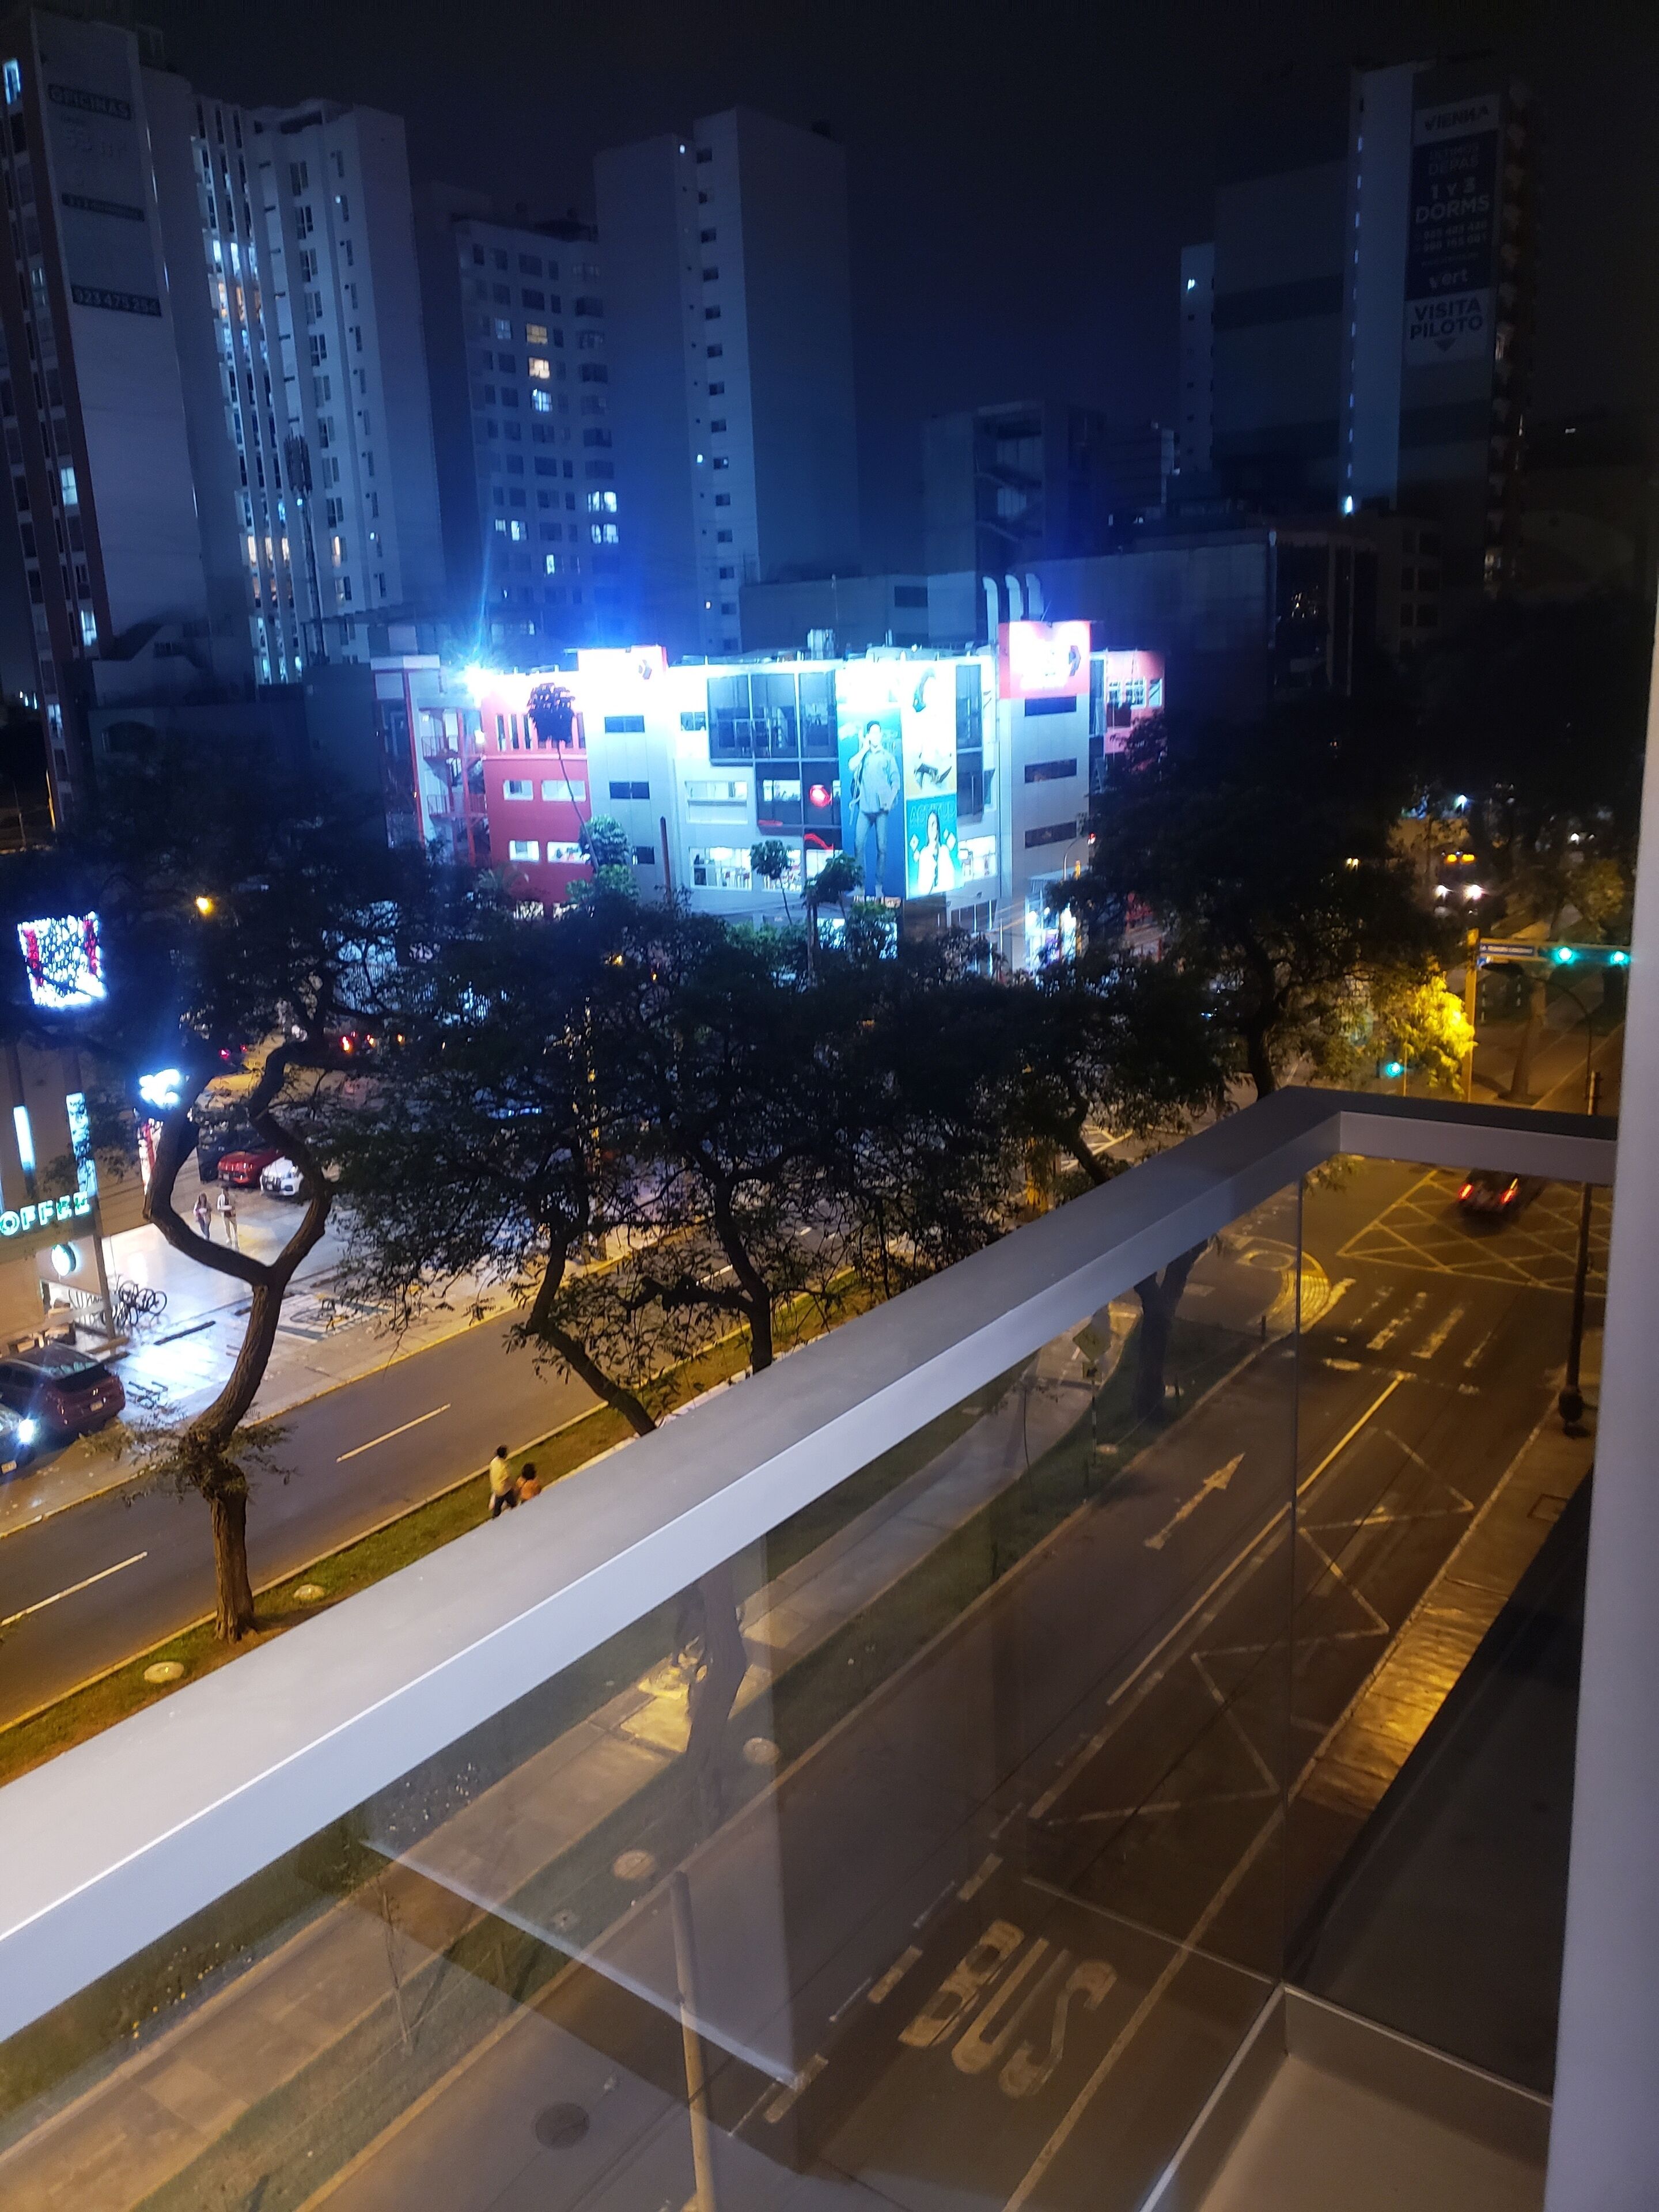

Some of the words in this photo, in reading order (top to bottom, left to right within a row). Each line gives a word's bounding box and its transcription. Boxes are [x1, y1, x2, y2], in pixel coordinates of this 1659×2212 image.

[1424, 104, 1489, 131] VIENNA
[1431, 183, 1439, 199] 1
[1415, 194, 1490, 224] DORMS
[1415, 298, 1481, 321] VISITA
[1410, 315, 1483, 339] PILOTO
[897, 1918, 1119, 2100] BUS
